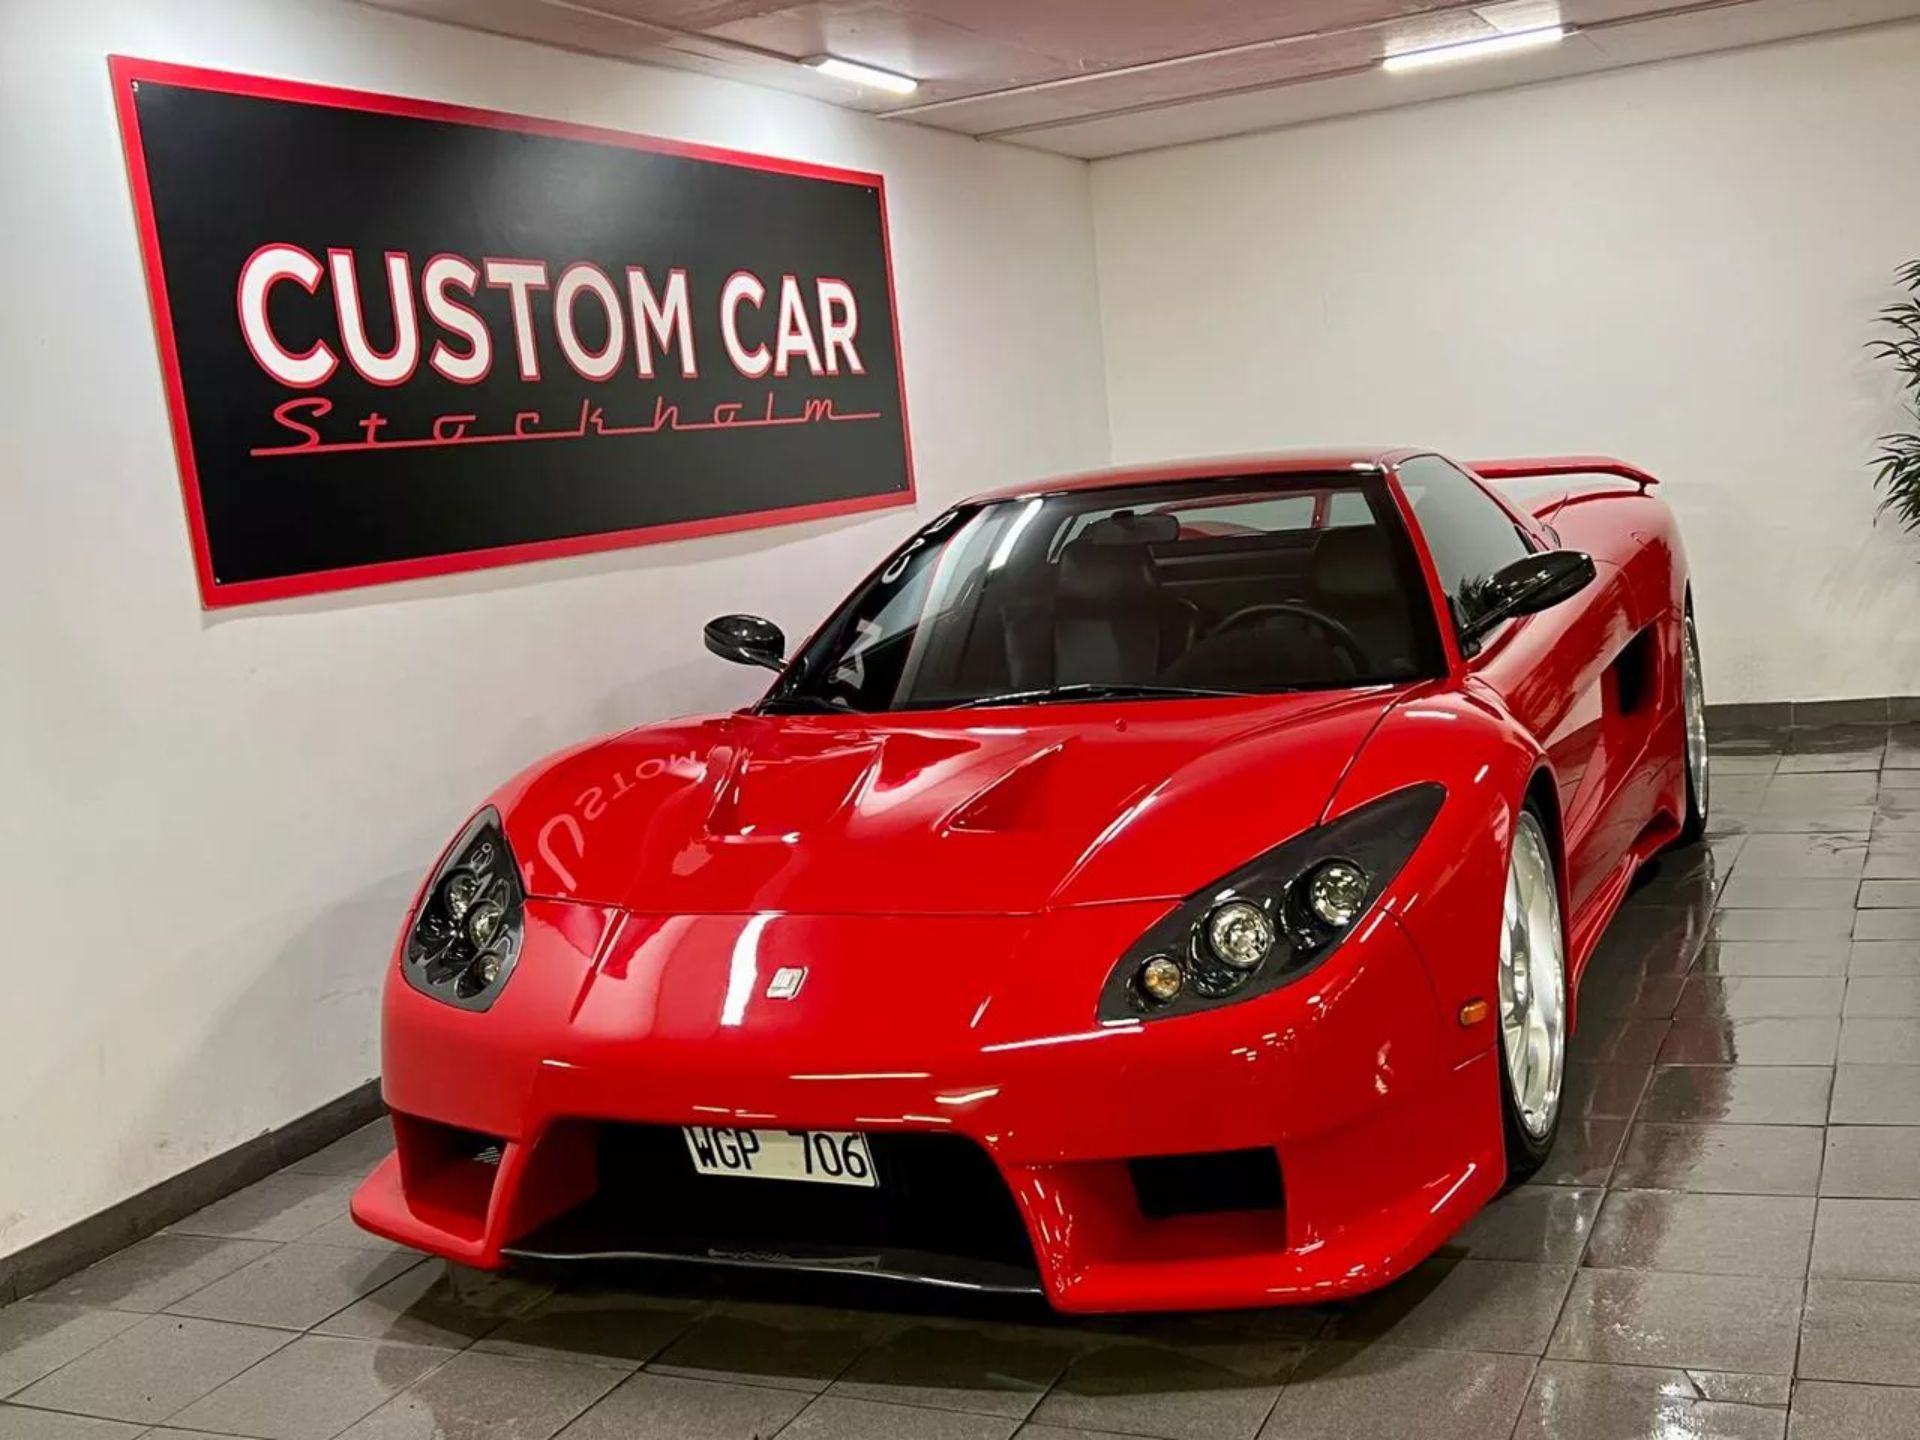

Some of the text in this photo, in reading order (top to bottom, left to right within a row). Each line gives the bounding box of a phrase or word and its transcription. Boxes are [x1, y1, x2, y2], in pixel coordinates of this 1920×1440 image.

[237, 242, 866, 389] CUSTOM CAR
[250, 391, 882, 456] Stockholm
[688, 1126, 868, 1178] WGP 706
